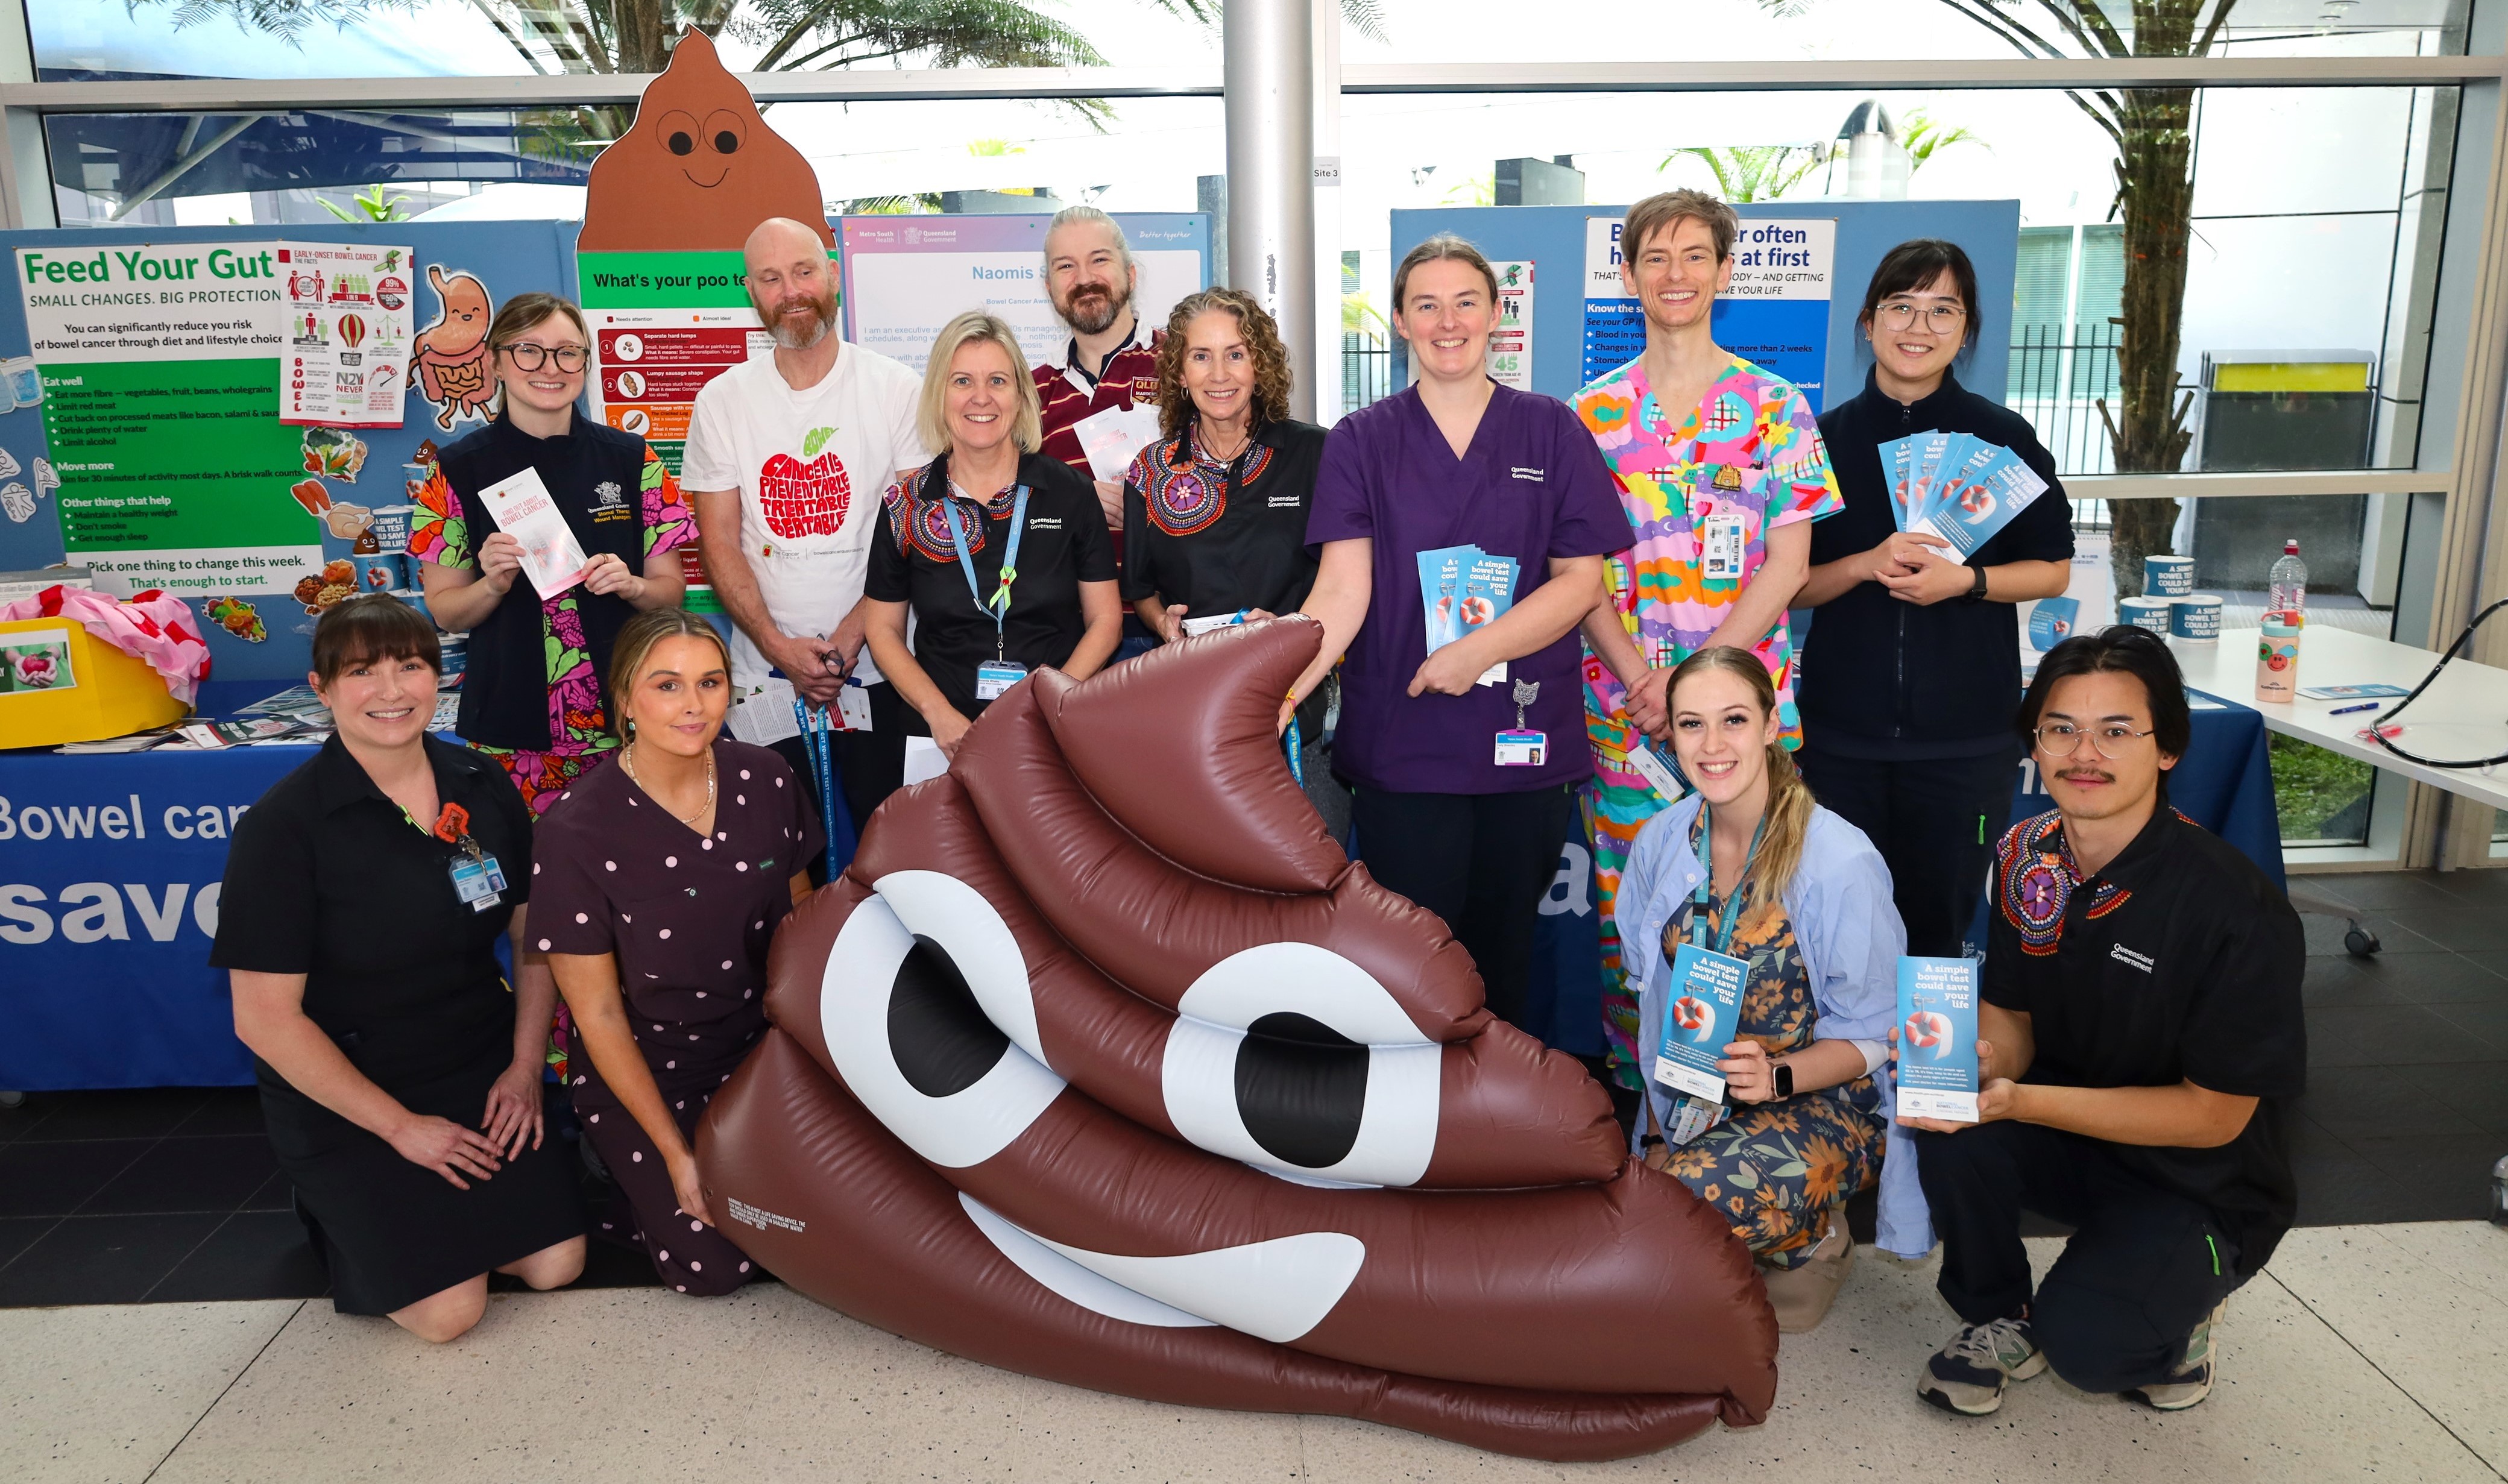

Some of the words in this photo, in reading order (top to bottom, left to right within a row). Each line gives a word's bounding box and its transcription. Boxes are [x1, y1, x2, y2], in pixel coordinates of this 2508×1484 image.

[1139, 230, 1162, 239] Better
[1164, 231, 1191, 241] together
[1752, 225, 1806, 244] often
[294, 251, 333, 259] EARLY-ONSET
[1741, 249, 1761, 266] at
[1768, 247, 1810, 266] first
[24, 251, 110, 283] Feed
[114, 251, 198, 281] Your
[208, 249, 275, 279] Gut
[972, 266, 1034, 280] Naomis
[593, 273, 650, 287] What's
[655, 275, 692, 290] your
[698, 275, 728, 290] poo
[1762, 273, 1783, 281] AND
[1785, 273, 1824, 281] GETTING
[30, 294, 78, 307] SMALL
[81, 293, 155, 306] CHANGES.
[160, 292, 183, 304] BIG
[189, 289, 281, 303] PROTECTION
[1587, 304, 1616, 312] Know
[1618, 303, 1634, 312] the
[65, 324, 84, 333] You
[109, 322, 171, 333] significantly
[174, 321, 208, 330] reduce
[233, 320, 252, 329] risk
[34, 340, 45, 349] of
[48, 339, 79, 349] bowel
[118, 337, 159, 348] through
[162, 337, 181, 345] diet
[185, 336, 204, 345] and
[206, 335, 248, 346] lifestyle
[1594, 343, 1628, 353] Changes
[1495, 356, 1517, 371] 45
[43, 377, 60, 386] Eat
[61, 376, 83, 386] well
[803, 427, 839, 457] BOWEL
[57, 462, 86, 471] Move
[761, 453, 830, 480] CANCER
[827, 451, 844, 474] IS
[1512, 473, 1543, 482] Government
[760, 471, 851, 499] PREVENTABLE
[62, 498, 93, 508] Other
[95, 497, 125, 508] things
[126, 496, 148, 506] that
[150, 495, 171, 506] help
[502, 508, 514, 517] FIND
[513, 503, 523, 512] OUT
[523, 495, 538, 507] ABOUT
[760, 491, 851, 518] TREATABLE
[500, 512, 524, 527] BOWEL
[523, 498, 549, 516] CANCER
[588, 505, 614, 514] Queensland
[765, 510, 848, 539] BEATABLE
[87, 561, 114, 572] Pick
[117, 562, 143, 571] one
[145, 559, 176, 572] thing
[179, 560, 192, 569] to
[195, 558, 239, 570] change
[242, 556, 266, 568] this
[268, 555, 306, 567] week.
[1485, 561, 1510, 570] simple
[129, 577, 166, 588] That's
[170, 576, 216, 588] enough
[219, 576, 232, 585] to
[236, 574, 268, 585] start.
[0, 794, 145, 840] Bowel
[2114, 943, 2154, 966] Queensland
[1709, 960, 1740, 975] simple
[2111, 951, 2152, 973] Government
[1692, 962, 1719, 977] bowel
[1722, 972, 1739, 983] test
[1917, 972, 1948, 981] bowel
[1935, 965, 1969, 975] simple
[1689, 970, 1715, 983] could
[1716, 979, 1737, 990] save
[1713, 986, 1736, 998] your
[1944, 992, 1969, 1001] your
[1719, 994, 1734, 1005] life
[1952, 1000, 1969, 1008] life
[772, 1218, 789, 1228] SHALLOW
